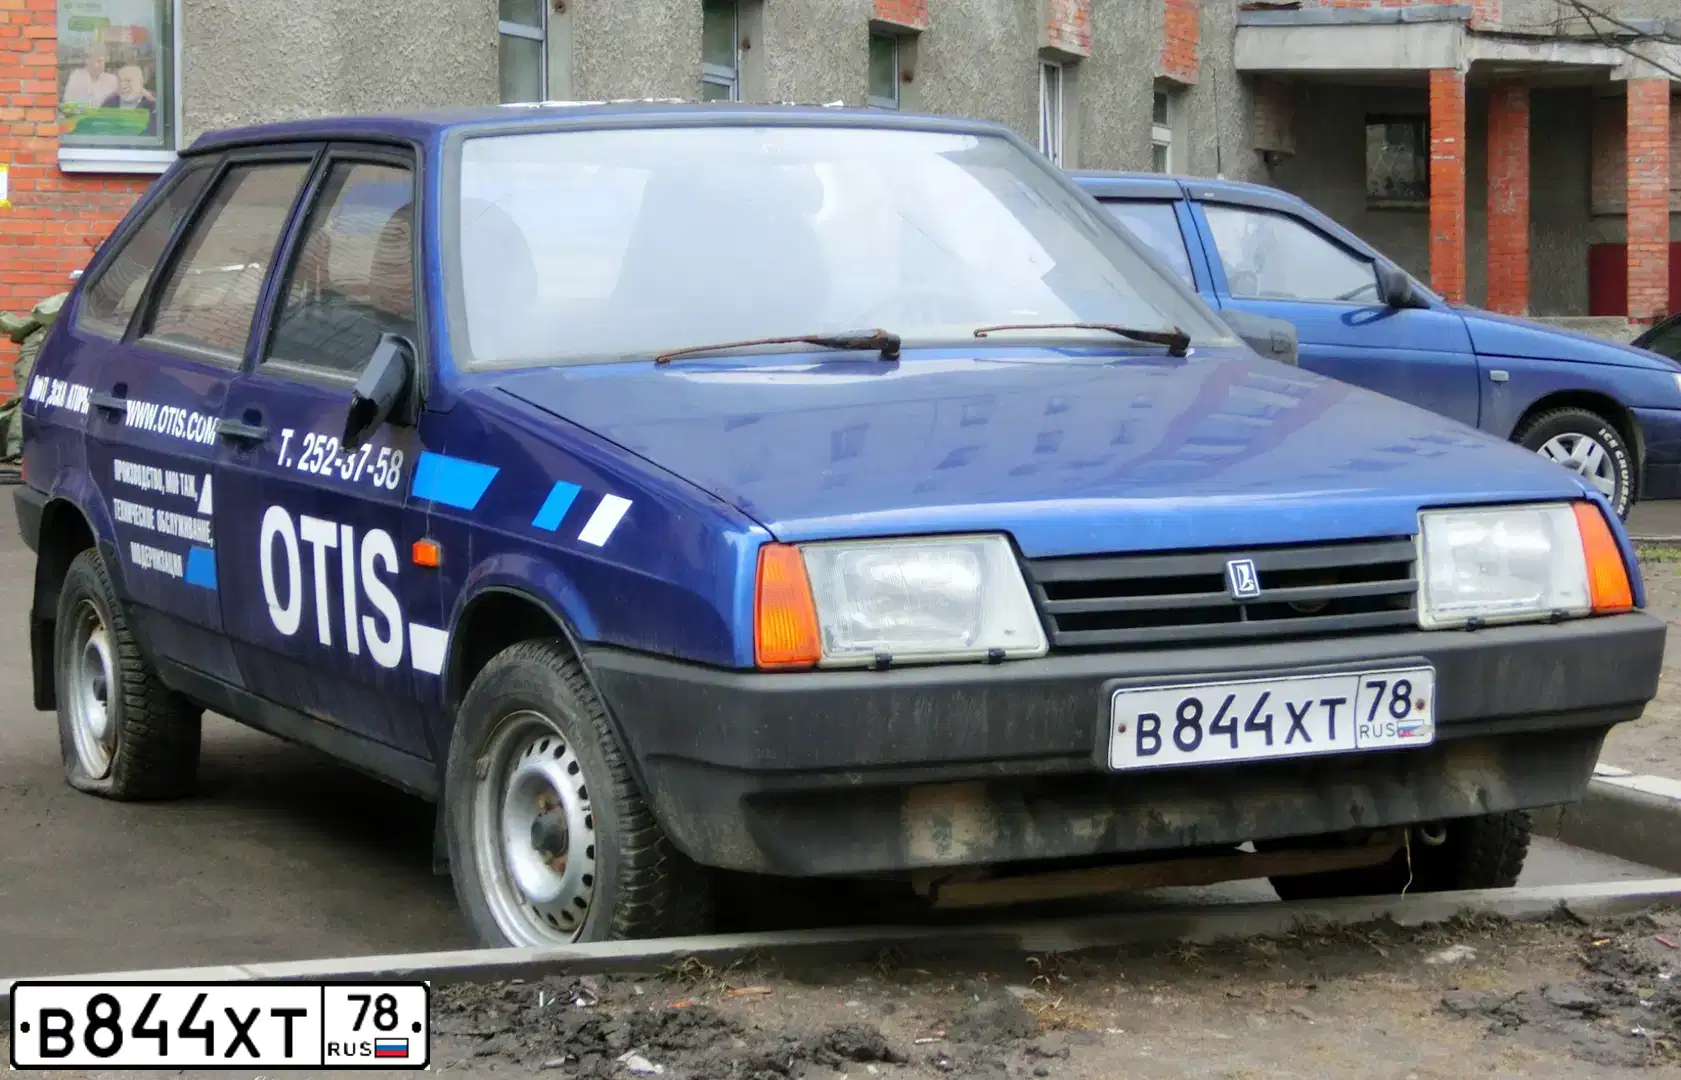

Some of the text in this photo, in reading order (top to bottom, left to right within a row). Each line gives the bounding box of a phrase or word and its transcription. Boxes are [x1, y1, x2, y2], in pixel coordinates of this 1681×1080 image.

[125, 399, 220, 446] WWW.OTIS.COM
[297, 432, 404, 490] 252-37-58
[260, 504, 404, 670] OTIS
[1136, 678, 1413, 757] В844ХТ 78
[1359, 721, 1396, 739] RUS
